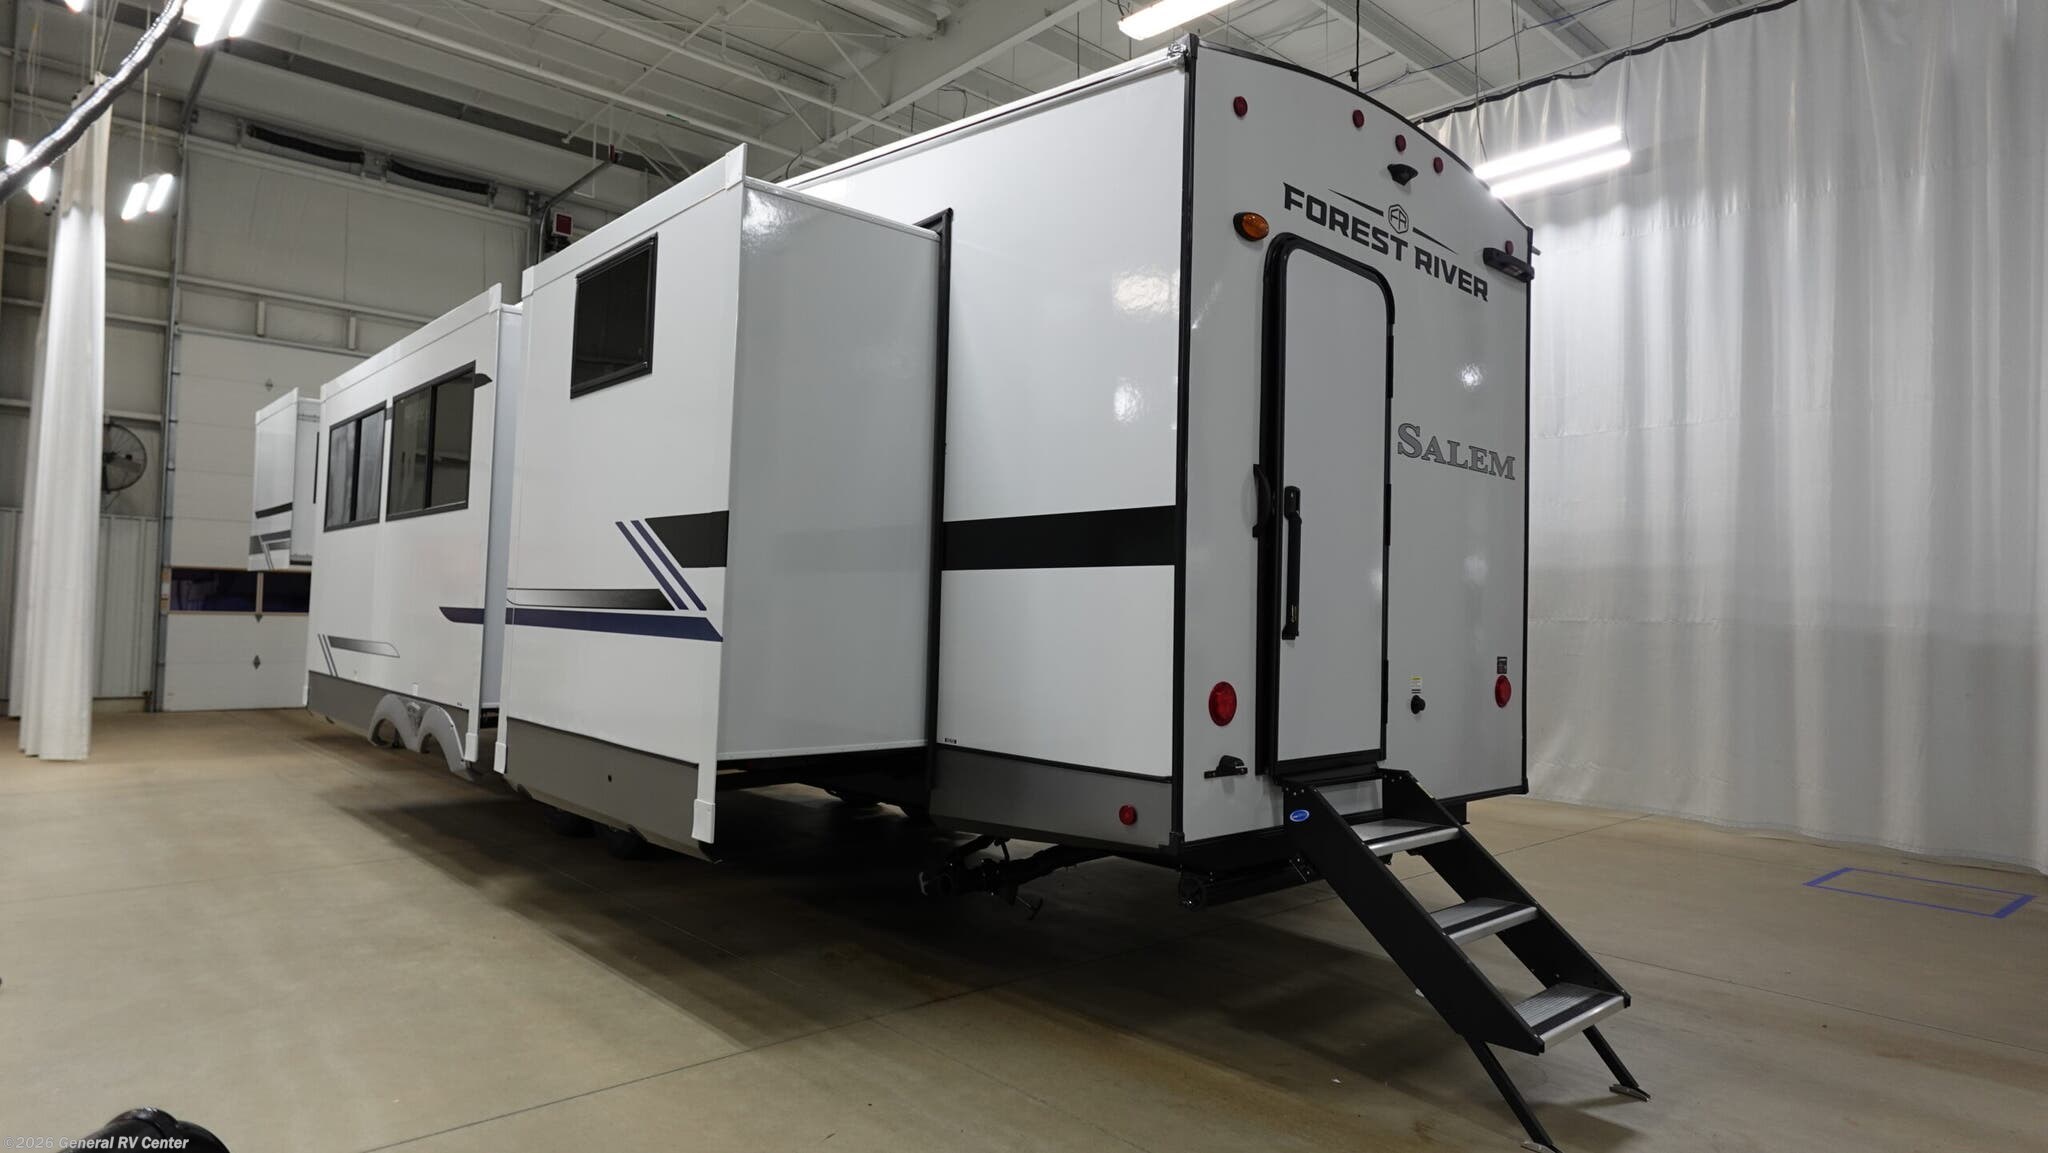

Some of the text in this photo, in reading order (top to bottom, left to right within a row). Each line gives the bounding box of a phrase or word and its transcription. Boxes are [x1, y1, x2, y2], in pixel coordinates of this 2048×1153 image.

[1283, 182, 1489, 302] FOREST RIVER
[1397, 422, 1516, 481] SALEM
